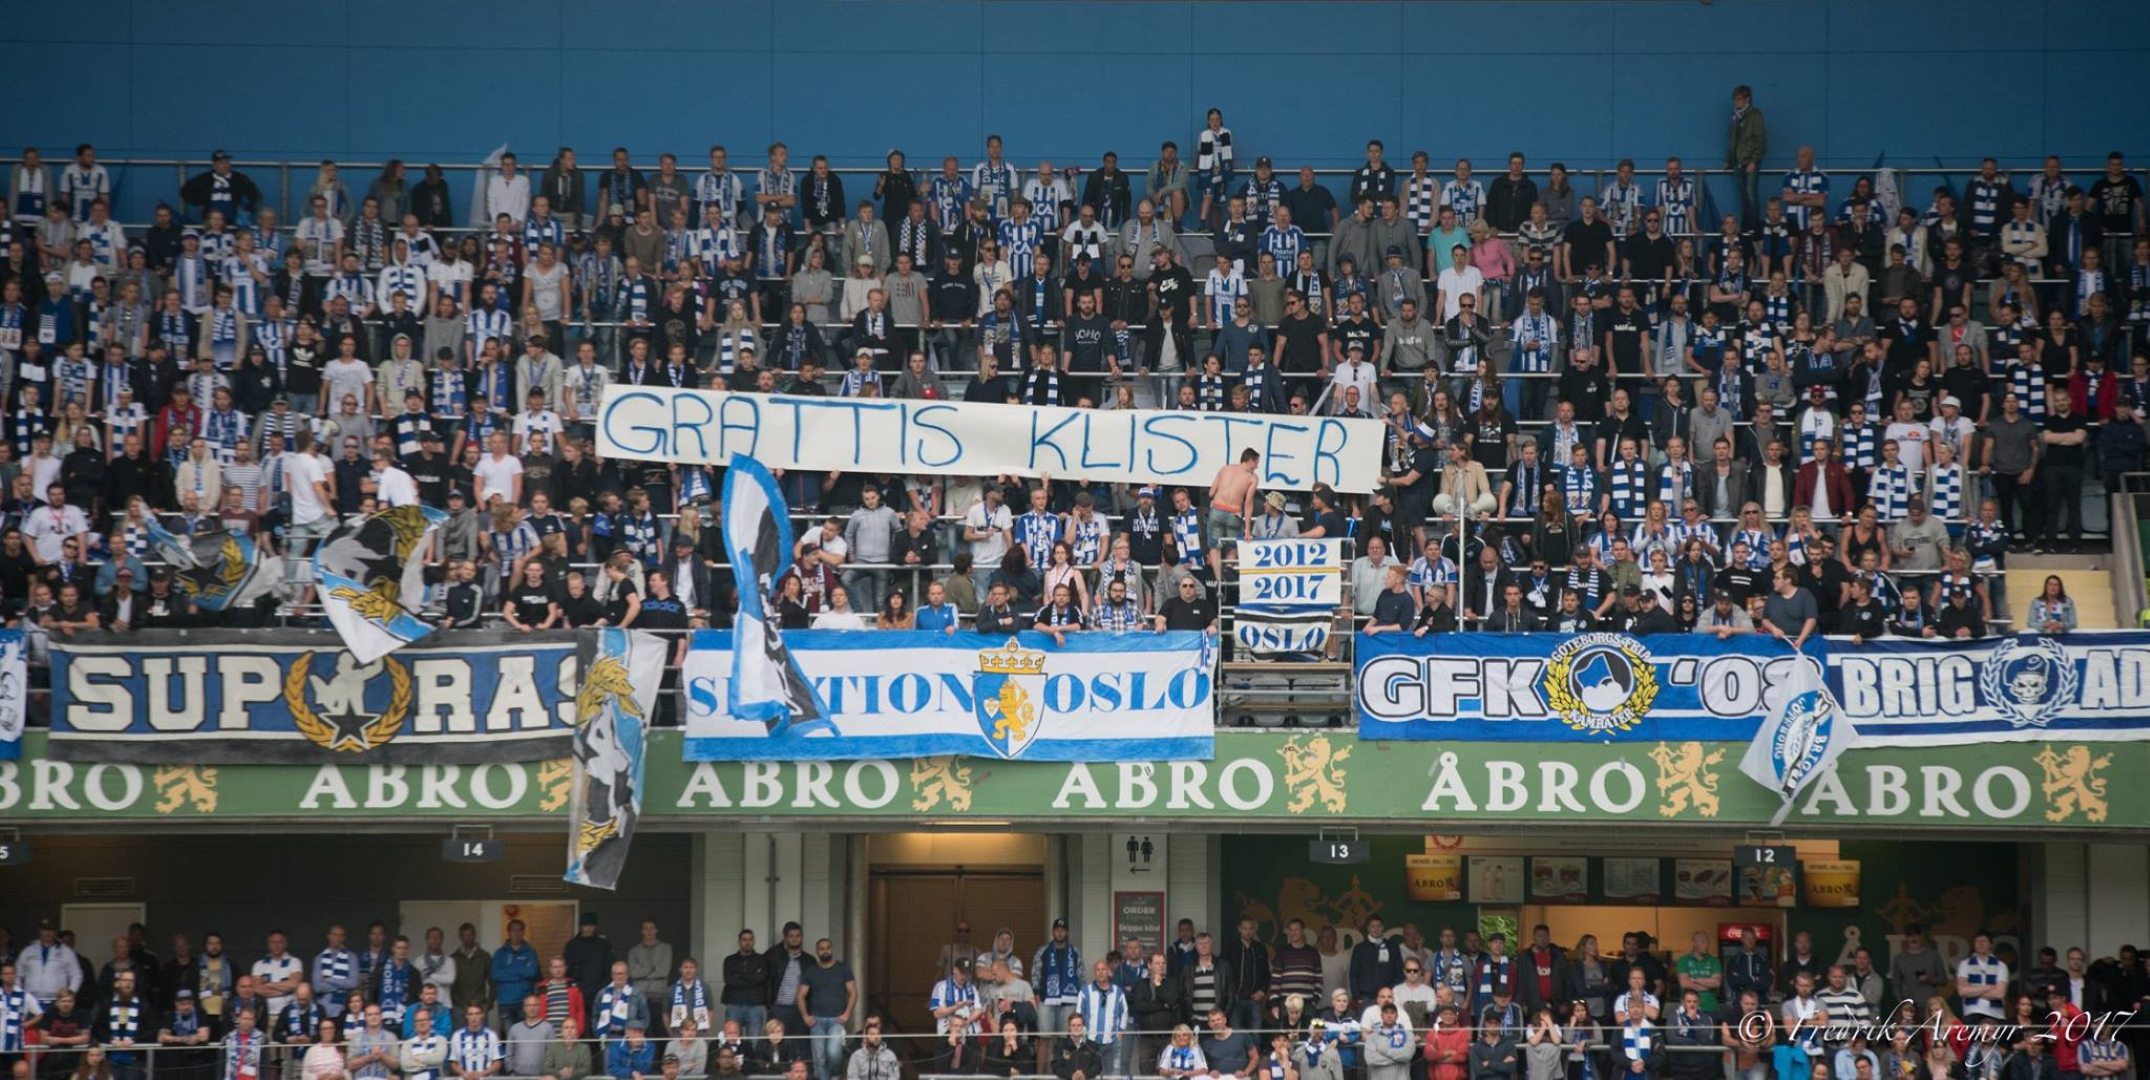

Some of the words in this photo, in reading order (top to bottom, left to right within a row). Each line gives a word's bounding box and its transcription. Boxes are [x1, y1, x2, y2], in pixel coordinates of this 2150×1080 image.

[603, 391, 962, 467] GRATTIS
[1030, 411, 1348, 486] KLISTER
[1254, 543, 1327, 567] 2012
[1254, 575, 1327, 600] 2017
[1240, 625, 1325, 651] OSLO
[66, 654, 282, 732] SUP
[688, 672, 973, 718] STION
[1044, 666, 1210, 714] OSLO
[1359, 654, 1548, 720] GFK
[1840, 656, 1977, 719] BRIG
[1569, 707, 1636, 730] KAMRATER
[1421, 751, 1648, 813] ÅBRO
[462, 843, 484, 858] 14
[1329, 845, 1350, 859] 13
[1755, 848, 1776, 863] 12
[1123, 906, 1156, 915] ORDER
